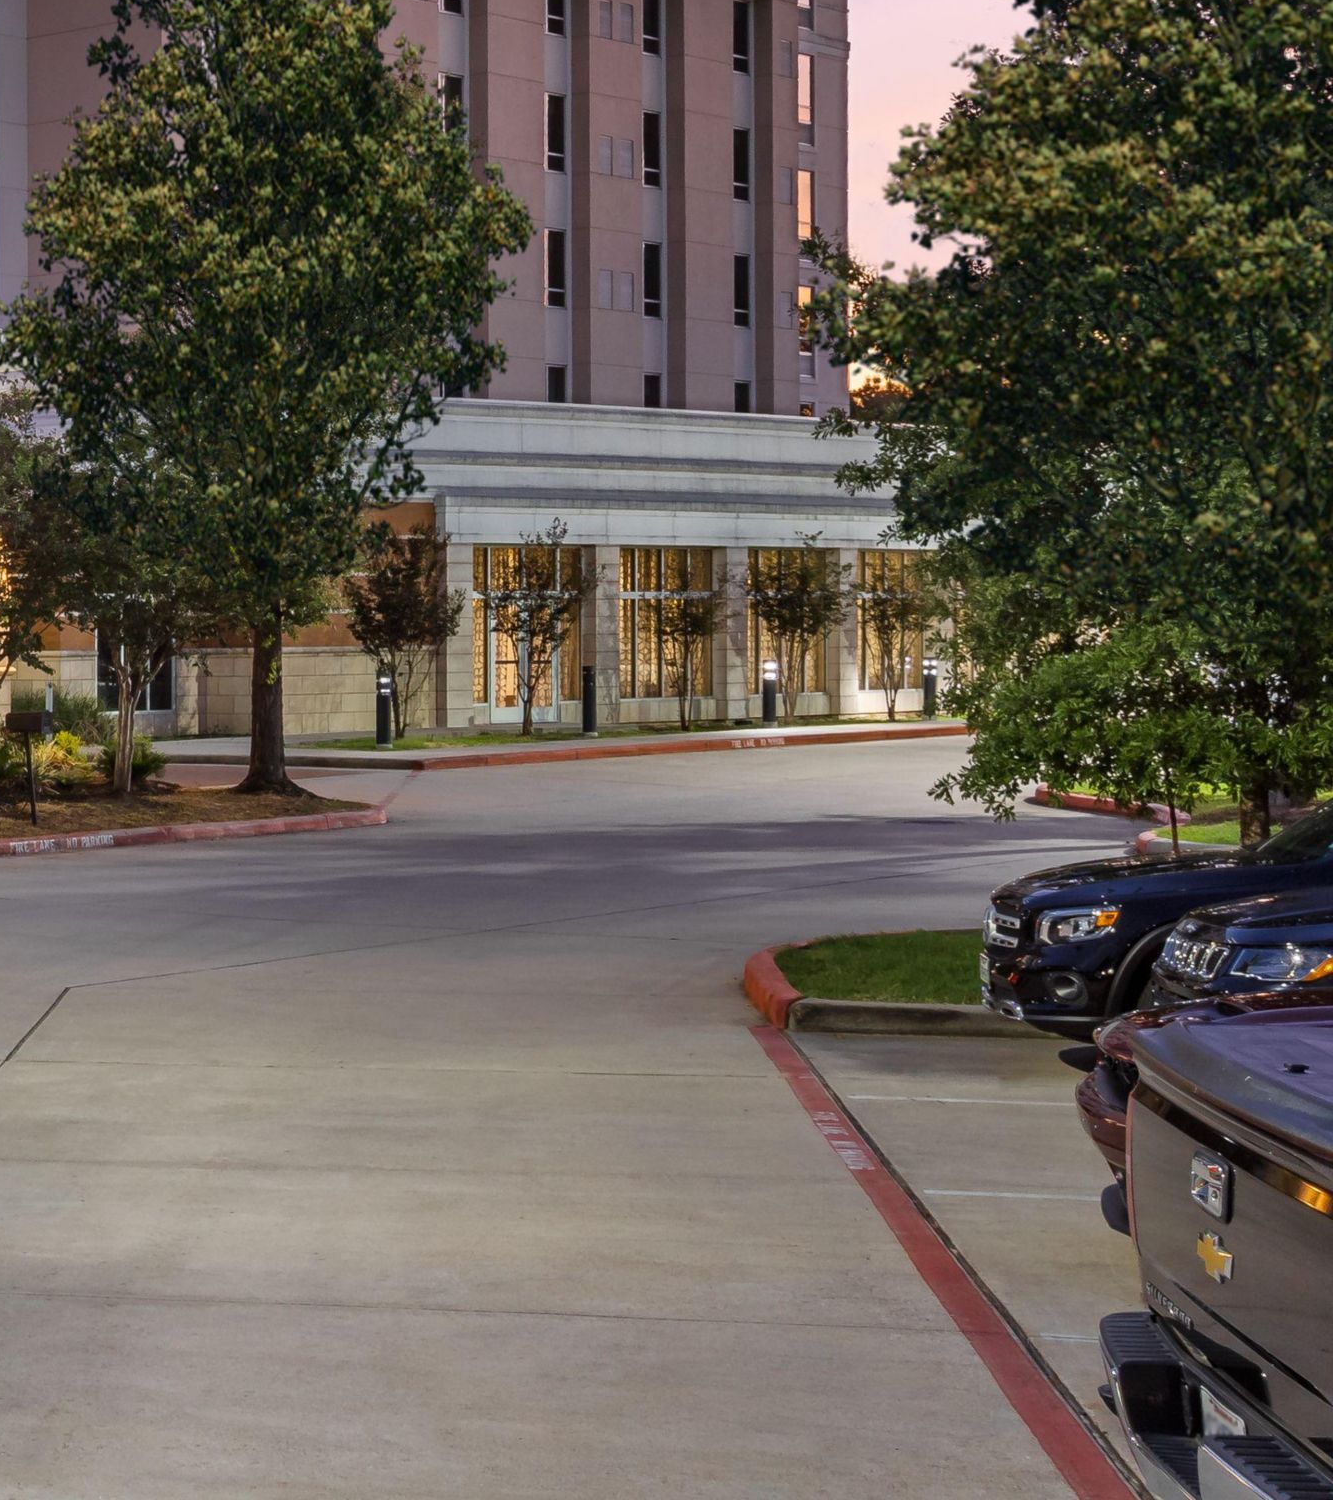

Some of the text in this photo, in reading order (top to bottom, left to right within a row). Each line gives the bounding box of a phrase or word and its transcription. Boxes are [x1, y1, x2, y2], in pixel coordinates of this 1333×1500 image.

[9, 841, 30, 853] FIRE
[66, 837, 77, 848] NO
[81, 834, 114, 848] PARKING
